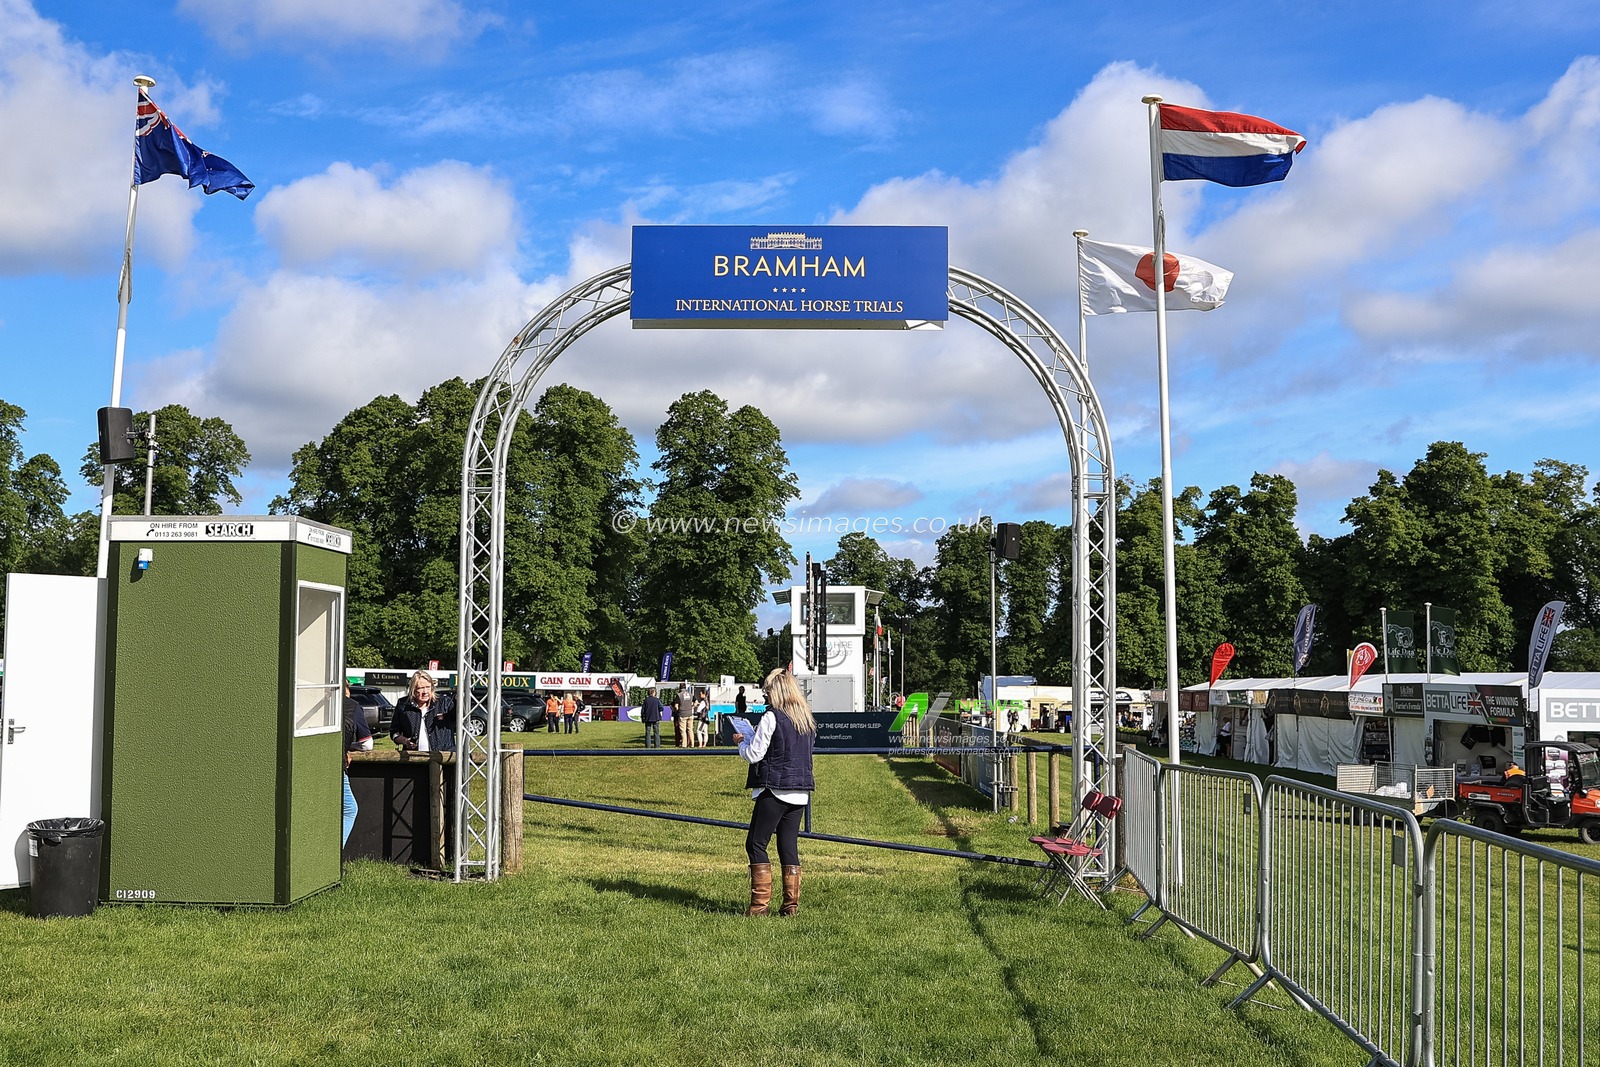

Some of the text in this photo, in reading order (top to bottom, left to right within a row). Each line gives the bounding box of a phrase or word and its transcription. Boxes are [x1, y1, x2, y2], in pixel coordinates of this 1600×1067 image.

[713, 255, 865, 278] BRAMHAM
[675, 299, 903, 313] INTERNATIONAL HORSE TRIALS
[206, 522, 254, 537] SEARCH
[540, 676, 564, 685] GAIN
[568, 677, 592, 685] GAIN
[1485, 695, 1519, 706] THE WINNING
[1490, 706, 1516, 718] FORMULA
